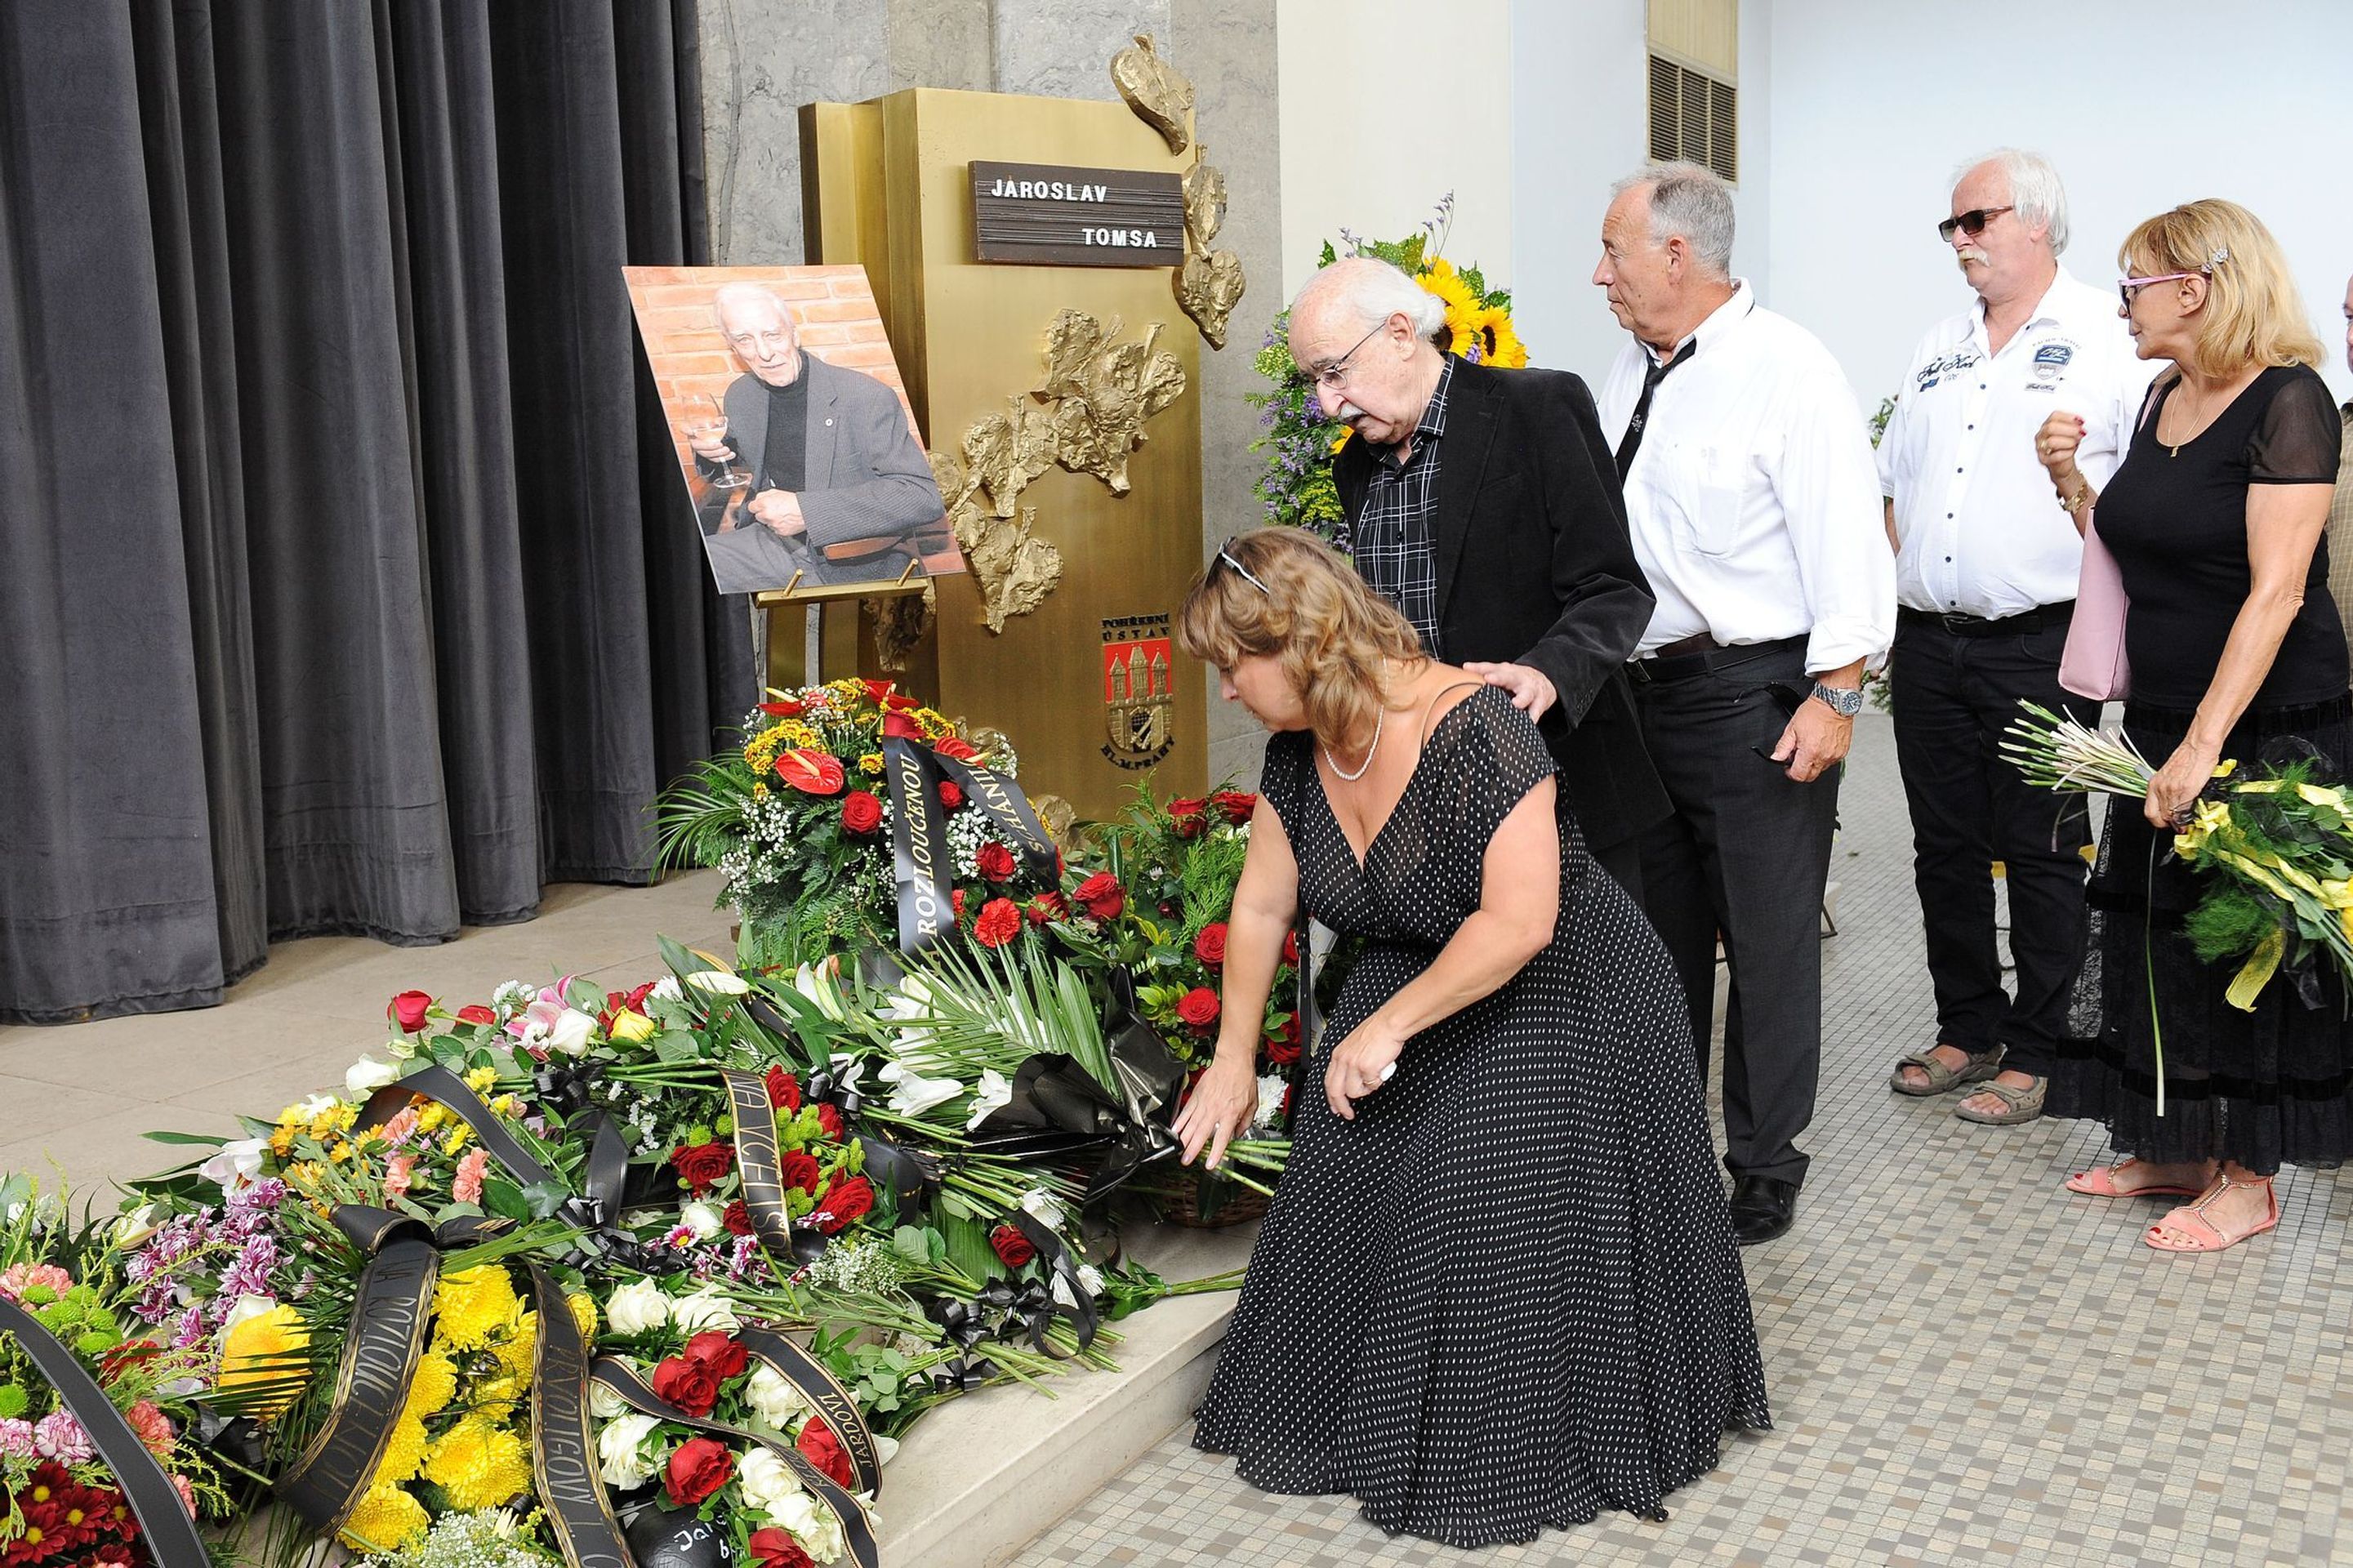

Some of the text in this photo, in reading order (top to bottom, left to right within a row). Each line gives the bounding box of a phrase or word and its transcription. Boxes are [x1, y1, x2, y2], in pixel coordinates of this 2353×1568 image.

[991, 178, 1107, 203] JAROSLAV
[1082, 228, 1157, 248] TOMSA
[900, 753, 938, 938] ROZLOUČENOU
[818, 1391, 871, 1468] JARDOVI
